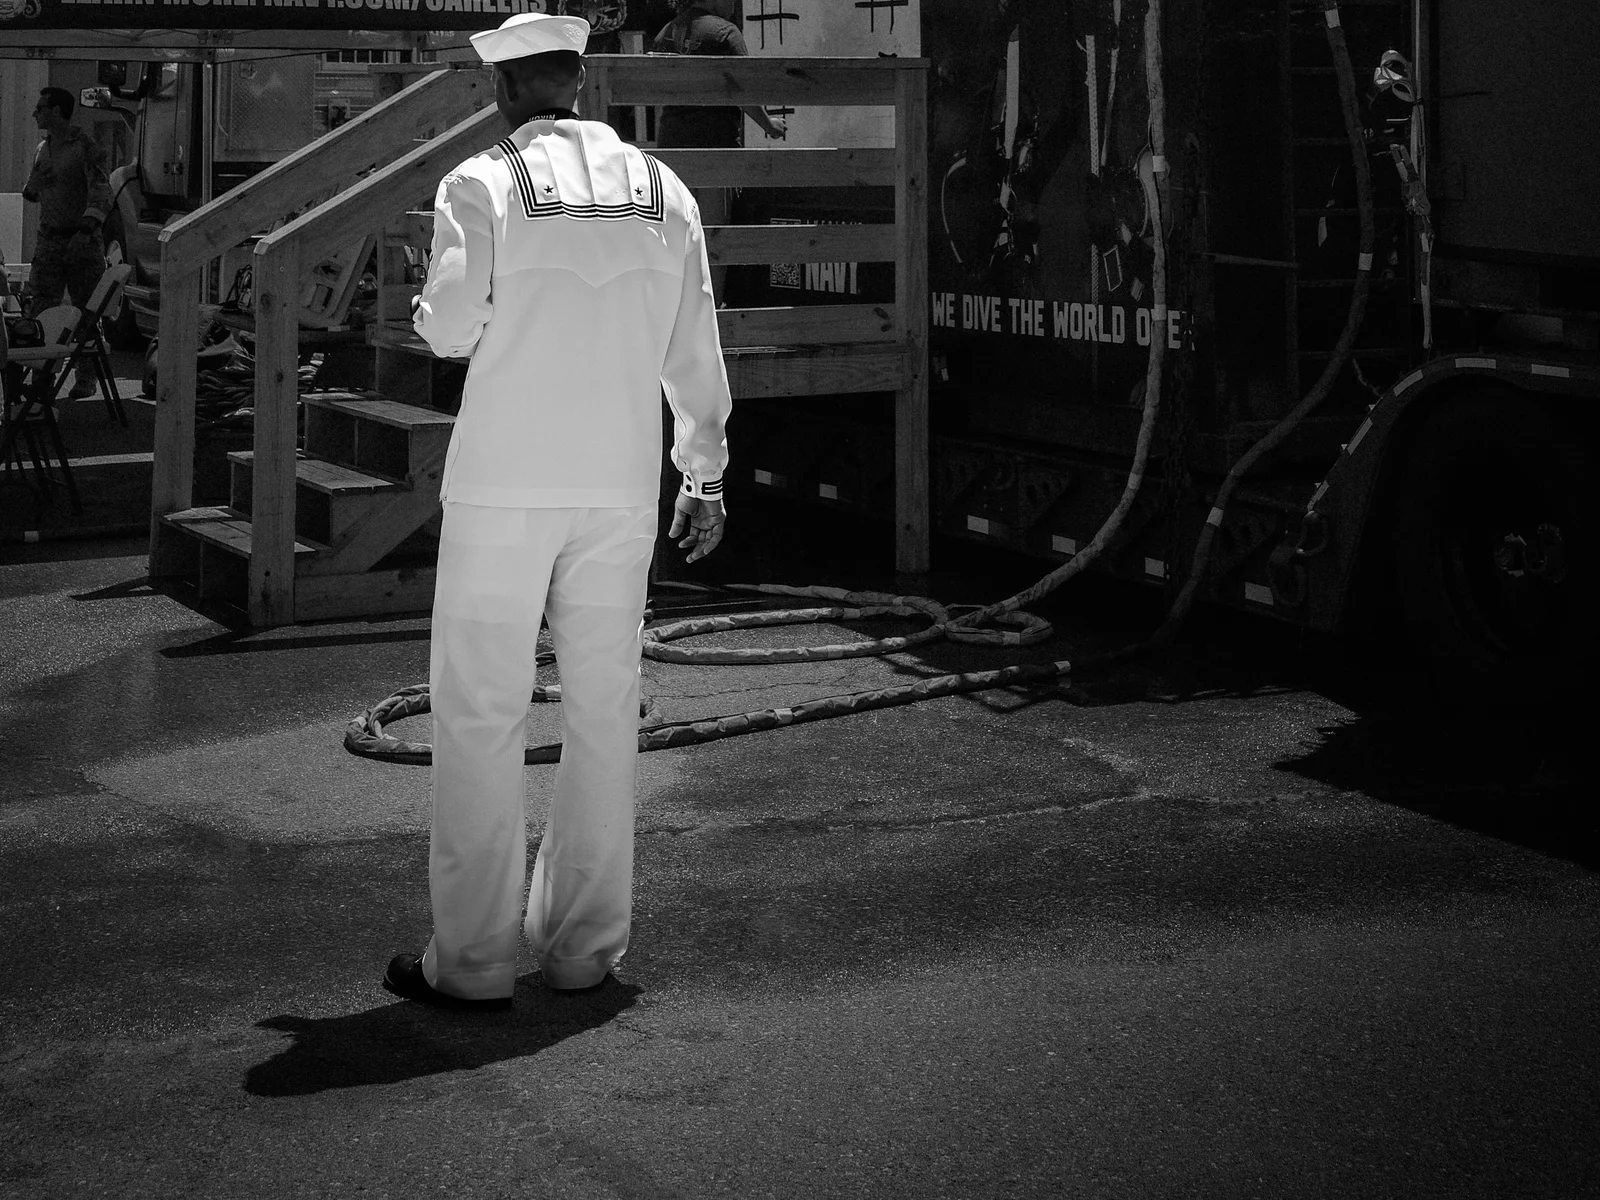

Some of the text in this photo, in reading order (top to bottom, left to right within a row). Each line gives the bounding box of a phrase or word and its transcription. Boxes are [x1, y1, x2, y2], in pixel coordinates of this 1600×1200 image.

[932, 291, 956, 328] WE
[962, 294, 1002, 332] DIVE
[1008, 298, 1045, 337] THE
[1053, 301, 1125, 344] WORLD
